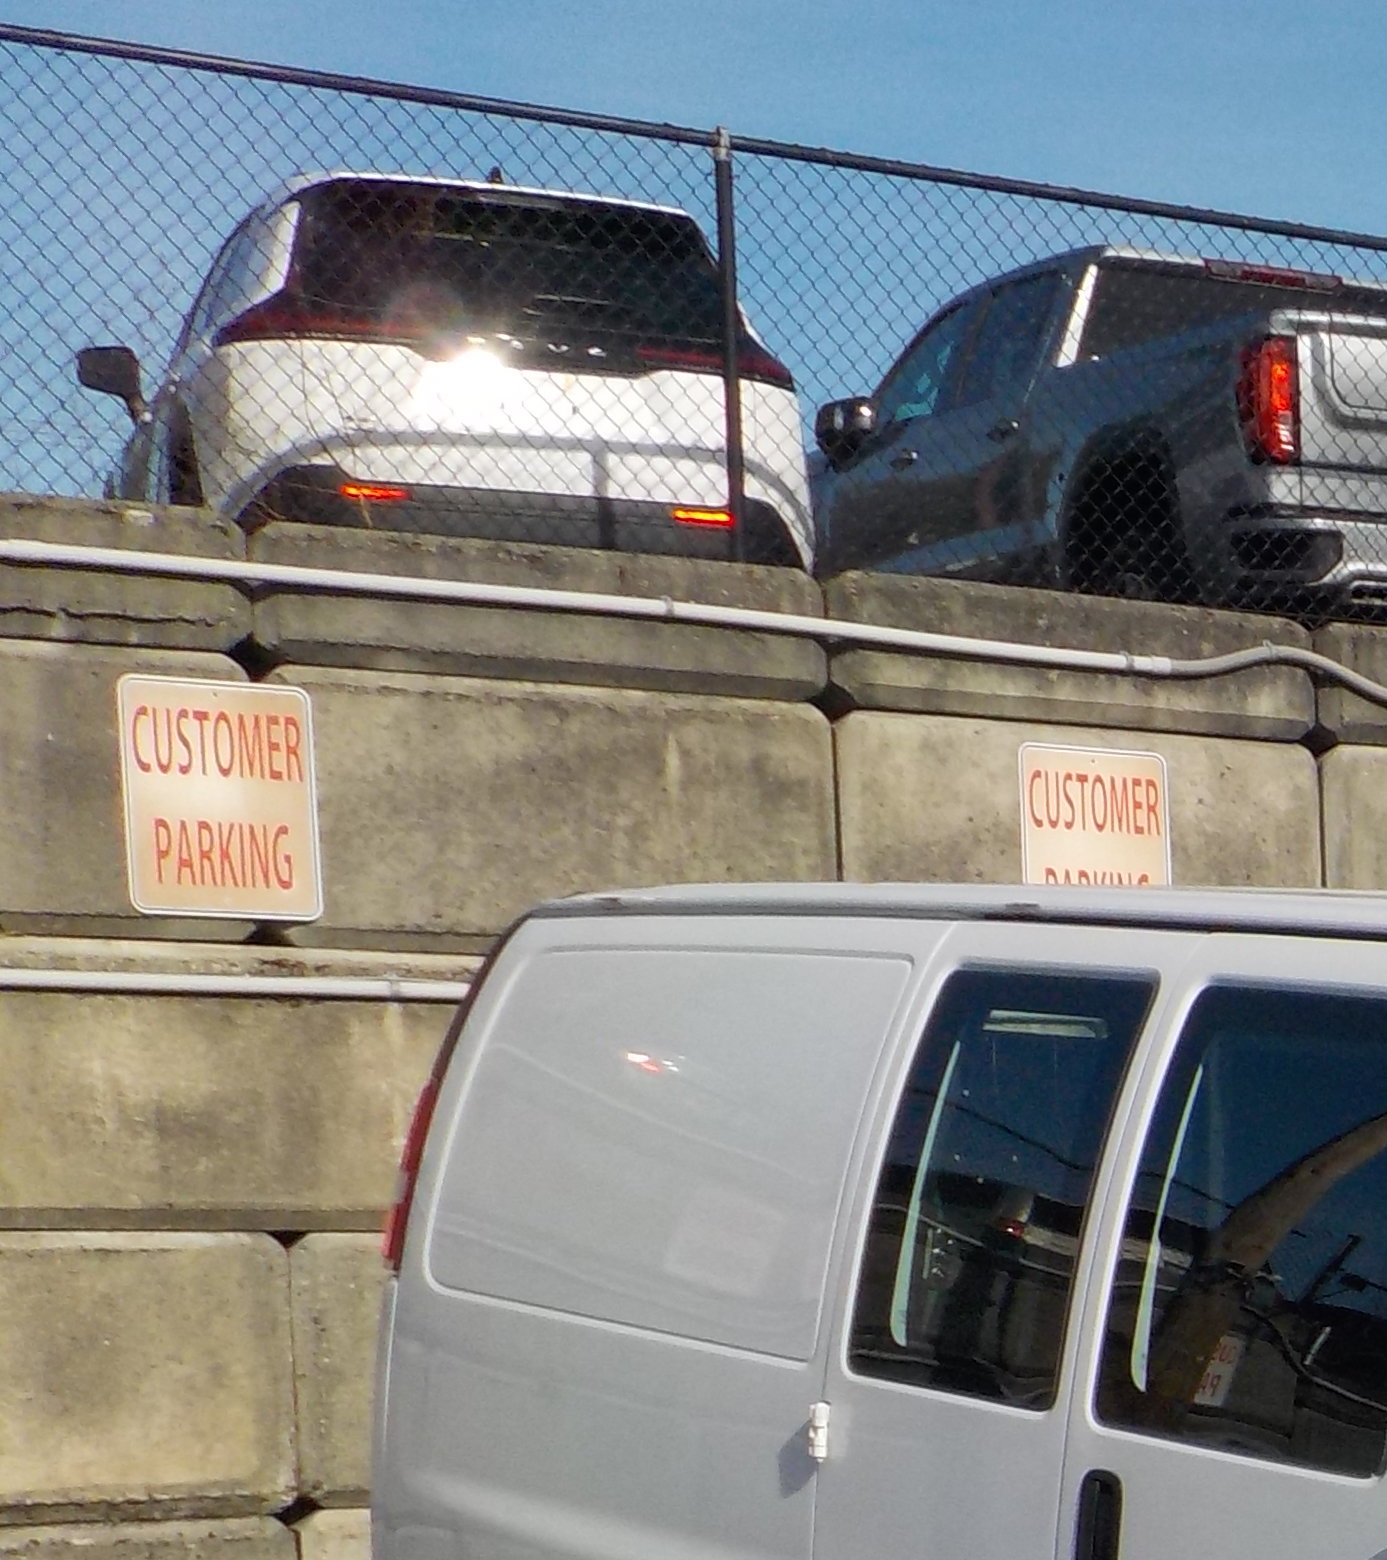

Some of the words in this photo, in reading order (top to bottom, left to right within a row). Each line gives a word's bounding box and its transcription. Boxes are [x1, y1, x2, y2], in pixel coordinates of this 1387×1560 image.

[132, 705, 304, 782] CUSTOMER
[1029, 769, 1161, 836] CUSTOMER
[154, 817, 293, 890] PARKING
